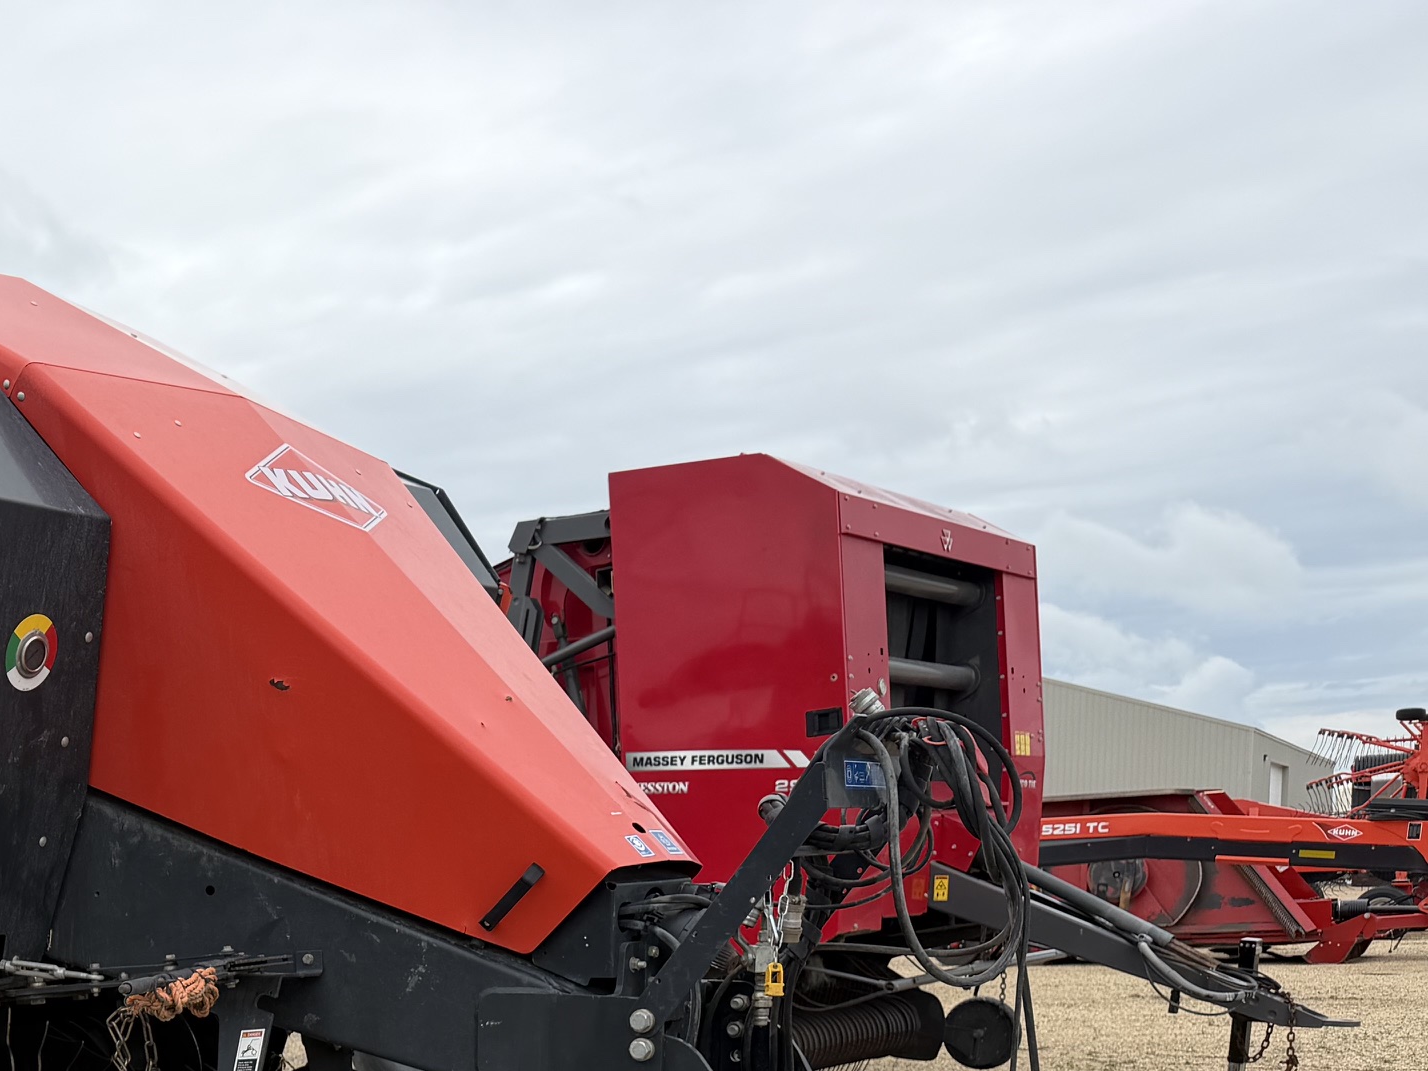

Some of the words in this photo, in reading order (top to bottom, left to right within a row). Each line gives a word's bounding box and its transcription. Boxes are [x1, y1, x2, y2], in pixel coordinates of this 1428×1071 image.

[259, 466, 380, 517] KUHN
[632, 754, 687, 768] MASSEY
[690, 753, 765, 766] FERGUSON
[639, 781, 689, 794] ESSTON
[1042, 823, 1080, 835] 5251
[1086, 822, 1109, 833] TC
